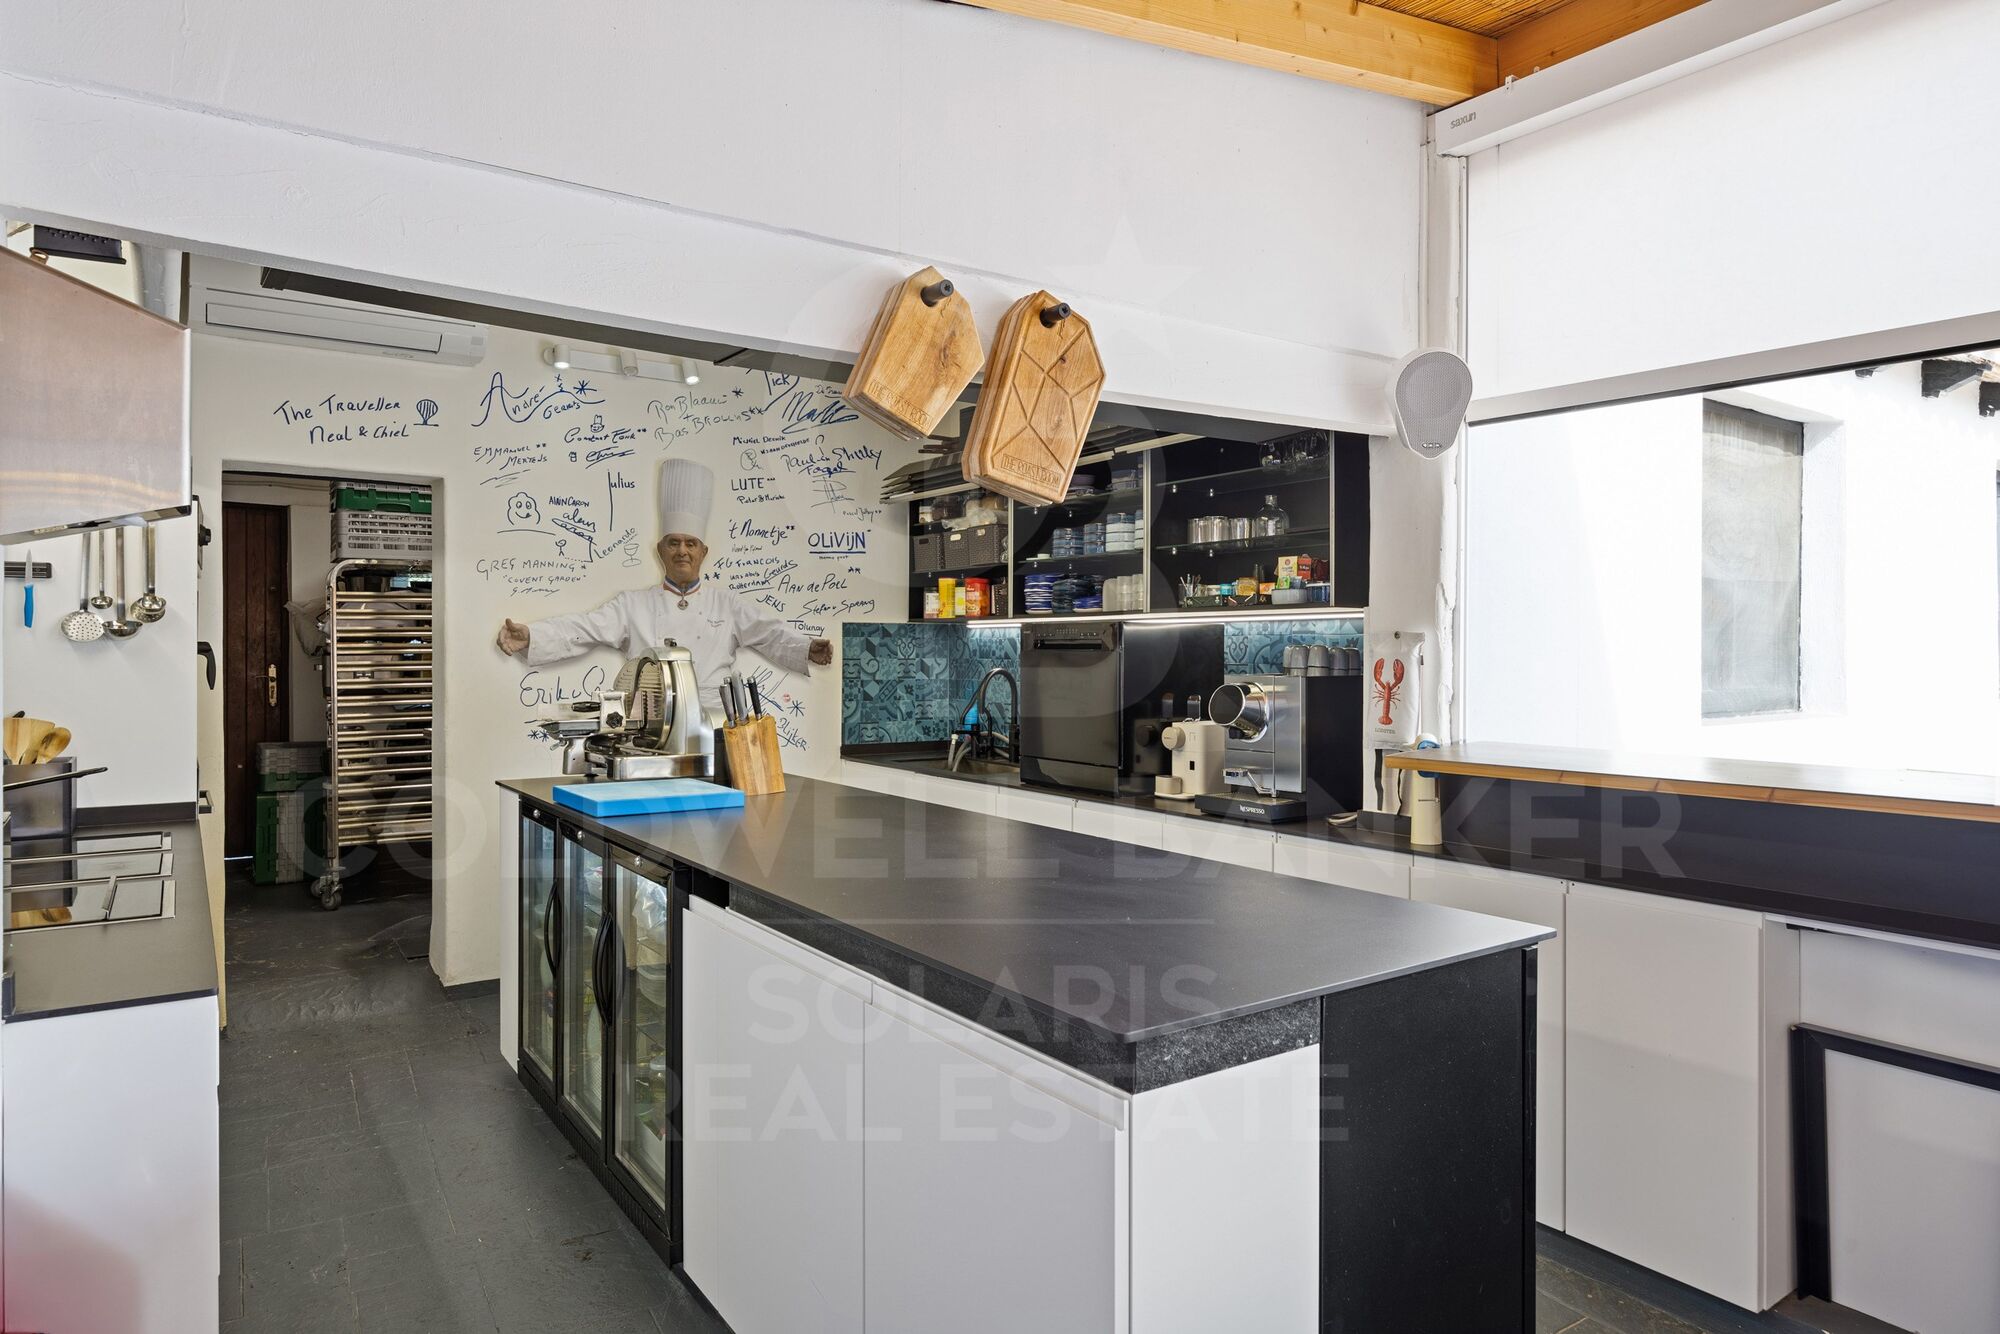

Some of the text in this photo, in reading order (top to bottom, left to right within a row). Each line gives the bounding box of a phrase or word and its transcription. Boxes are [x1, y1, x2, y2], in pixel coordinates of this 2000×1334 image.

[1450, 111, 1477, 129] saxun
[273, 400, 313, 425] The
[358, 426, 368, 437] &
[731, 477, 764, 491] LUTE
[522, 560, 575, 572] MANNING
[756, 594, 786, 613] JENS
[520, 671, 569, 707] Erik
[1240, 804, 1265, 815] NESPRESSO
